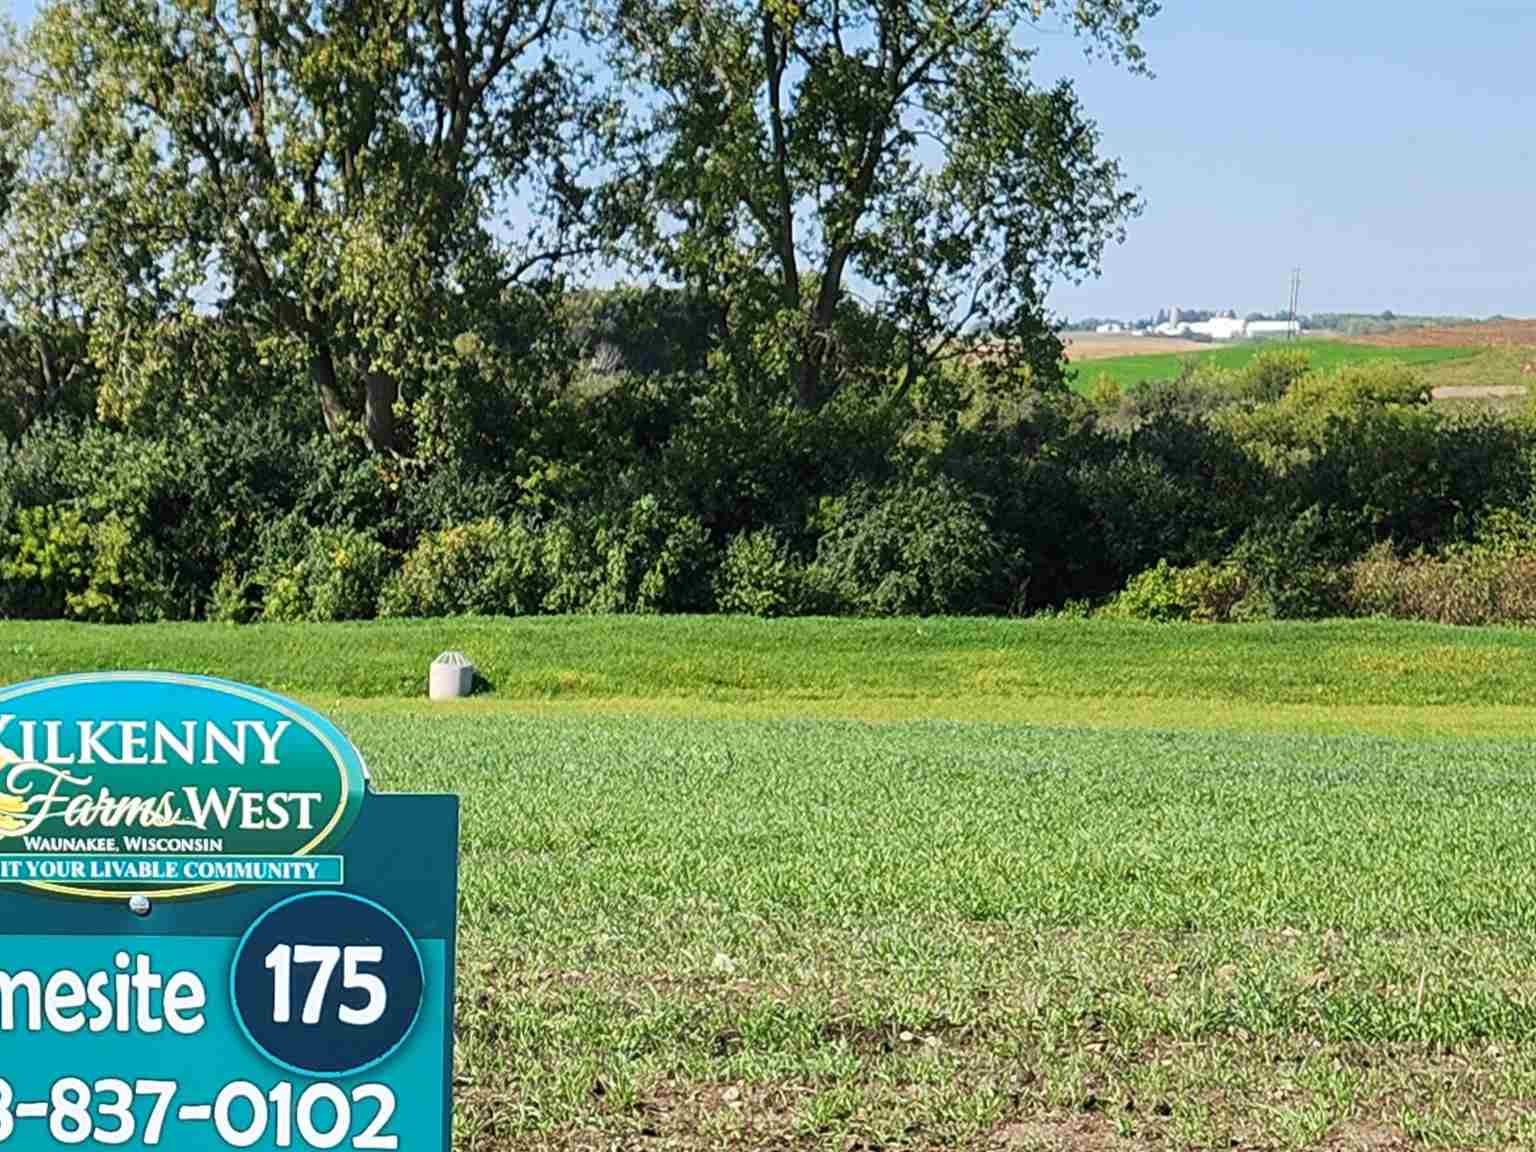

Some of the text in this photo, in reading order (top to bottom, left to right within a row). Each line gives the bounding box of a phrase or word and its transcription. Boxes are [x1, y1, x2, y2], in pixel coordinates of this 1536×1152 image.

[6, 762, 322, 836] Farms WEST
[23, 836, 223, 853] WAUNAKEE, WISCONSIN
[4, 861, 25, 878] IT
[27, 861, 86, 879] YOUR
[91, 861, 179, 879] LIVABLE
[185, 862, 320, 880] COMMUNITY
[264, 944, 388, 1026] 175
